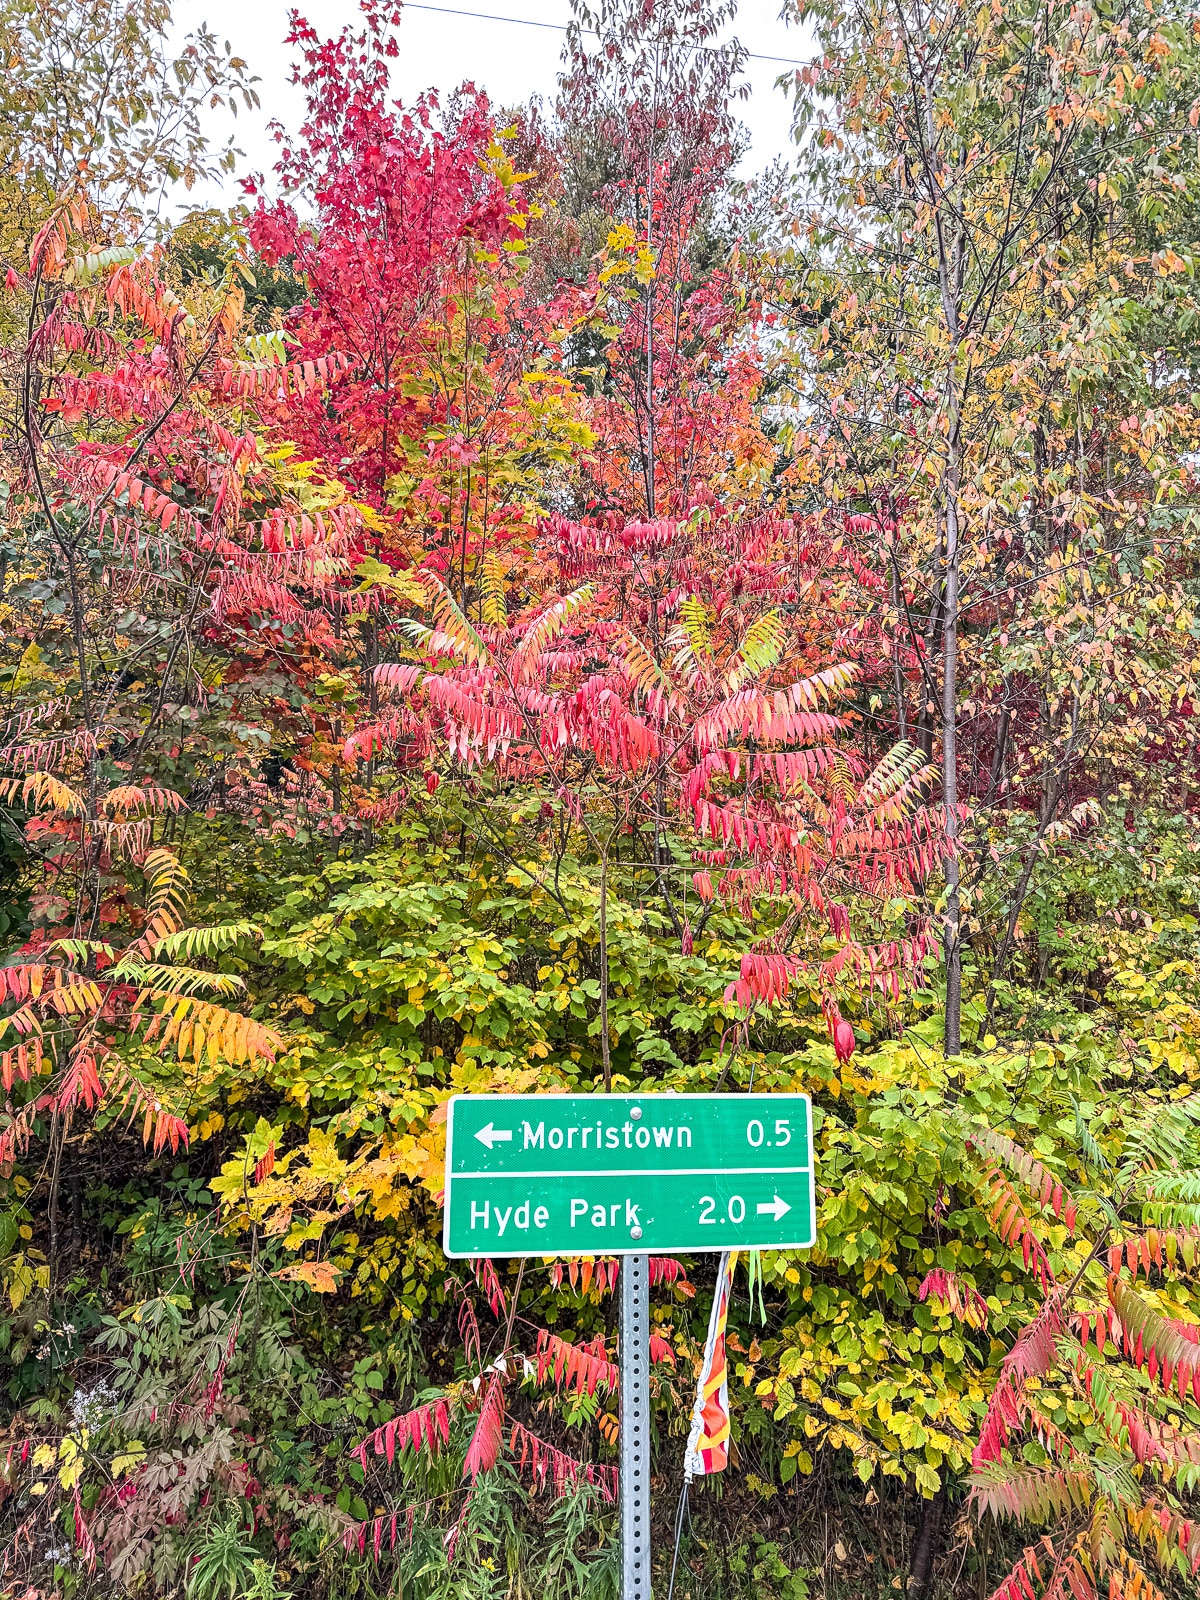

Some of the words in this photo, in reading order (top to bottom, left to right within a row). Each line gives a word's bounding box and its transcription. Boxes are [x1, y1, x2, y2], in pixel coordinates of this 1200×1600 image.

[522, 1120, 692, 1150] Morristown
[746, 1119, 792, 1147] 0.5
[470, 1200, 550, 1236] Hyde
[570, 1198, 640, 1227] Park
[698, 1195, 746, 1225] 2.0
